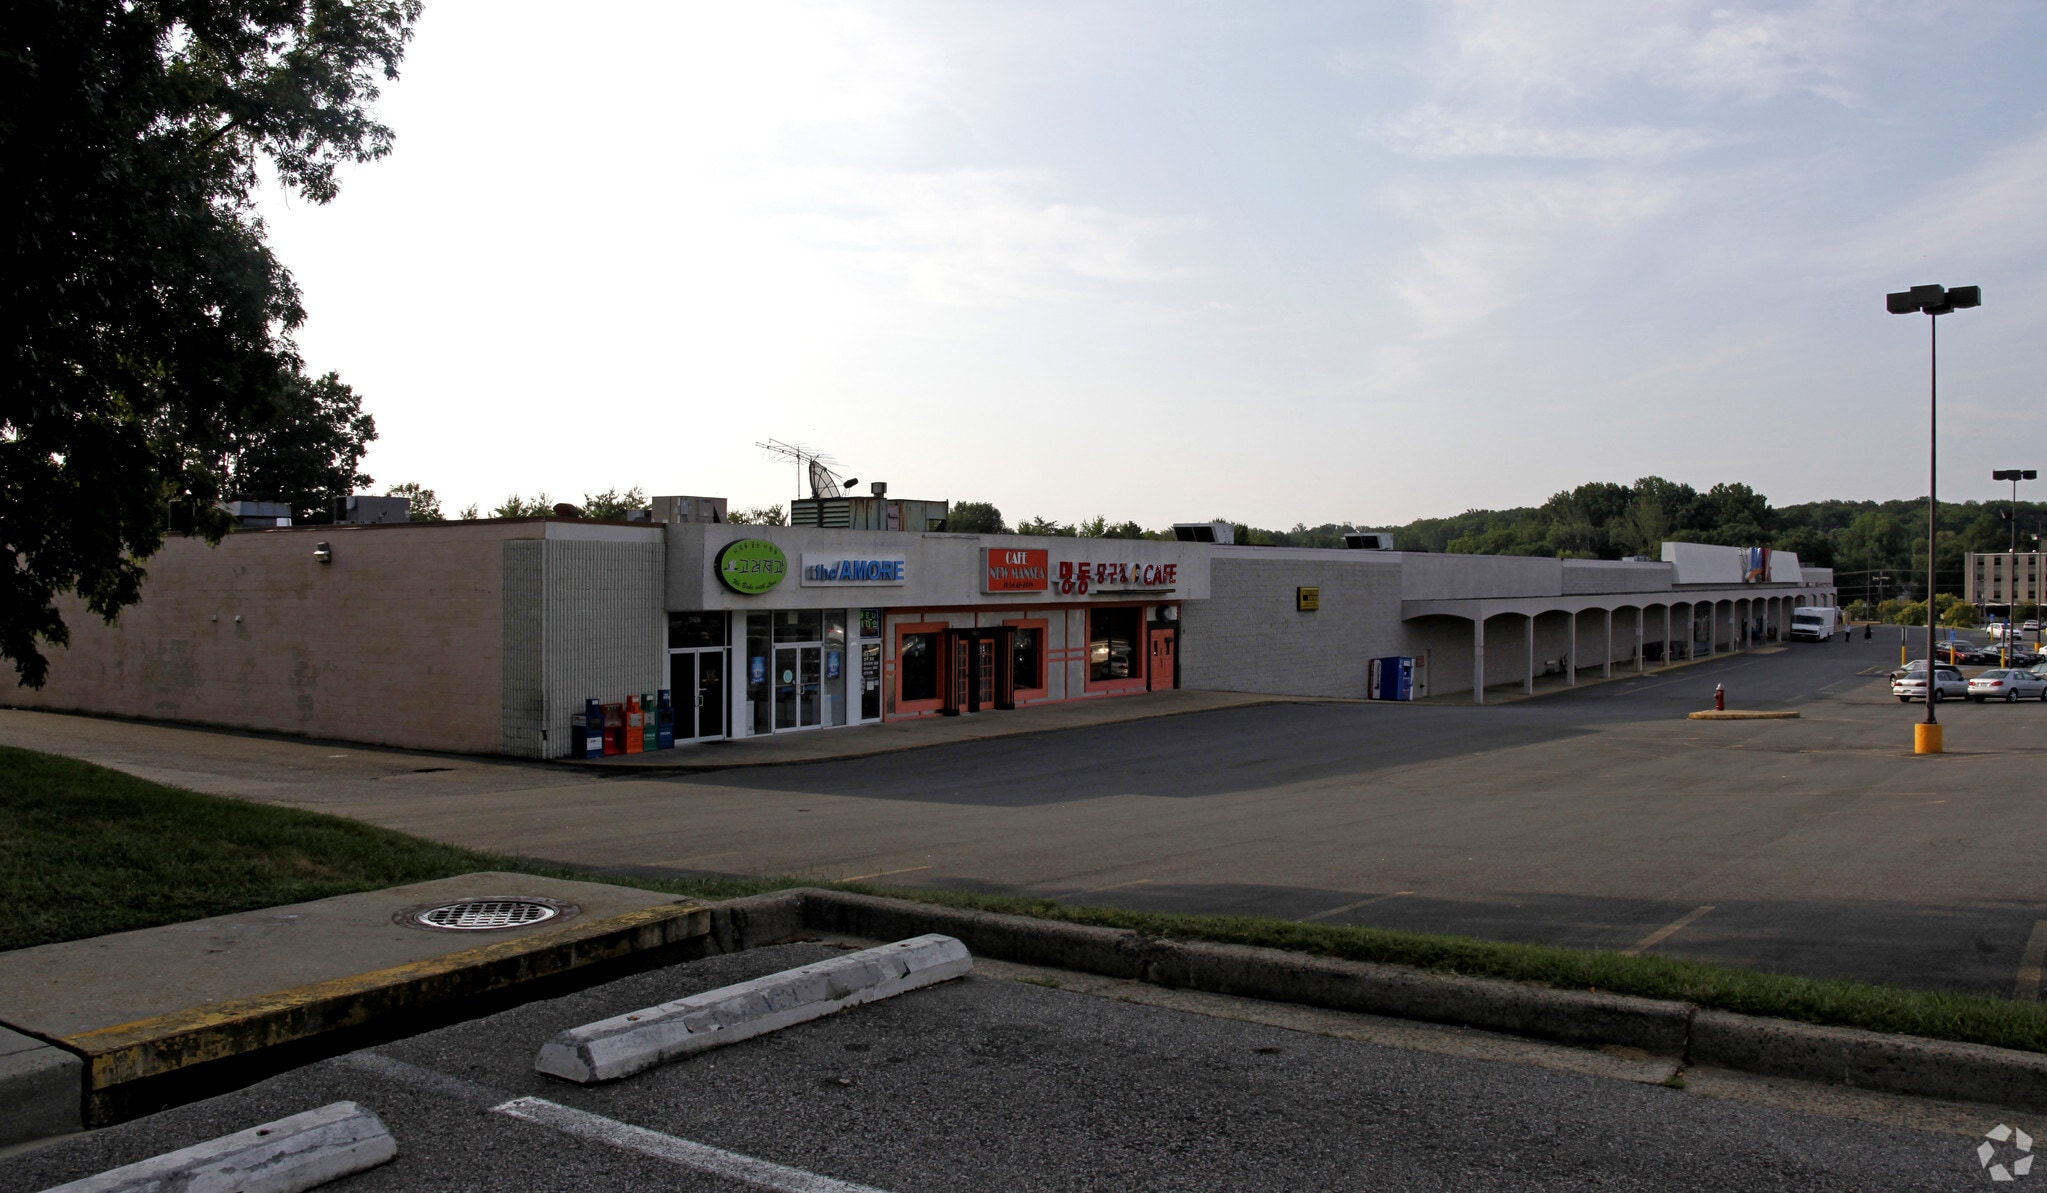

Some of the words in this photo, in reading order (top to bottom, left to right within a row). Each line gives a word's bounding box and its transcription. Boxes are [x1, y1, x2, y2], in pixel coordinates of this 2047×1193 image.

[1006, 551, 1028, 565] CAFE
[739, 559, 784, 574] 고려제과
[839, 560, 904, 580] AMORE
[990, 566, 1008, 580] NEW
[1059, 561, 1091, 595] 명동
[1144, 564, 1177, 585] CAFE
